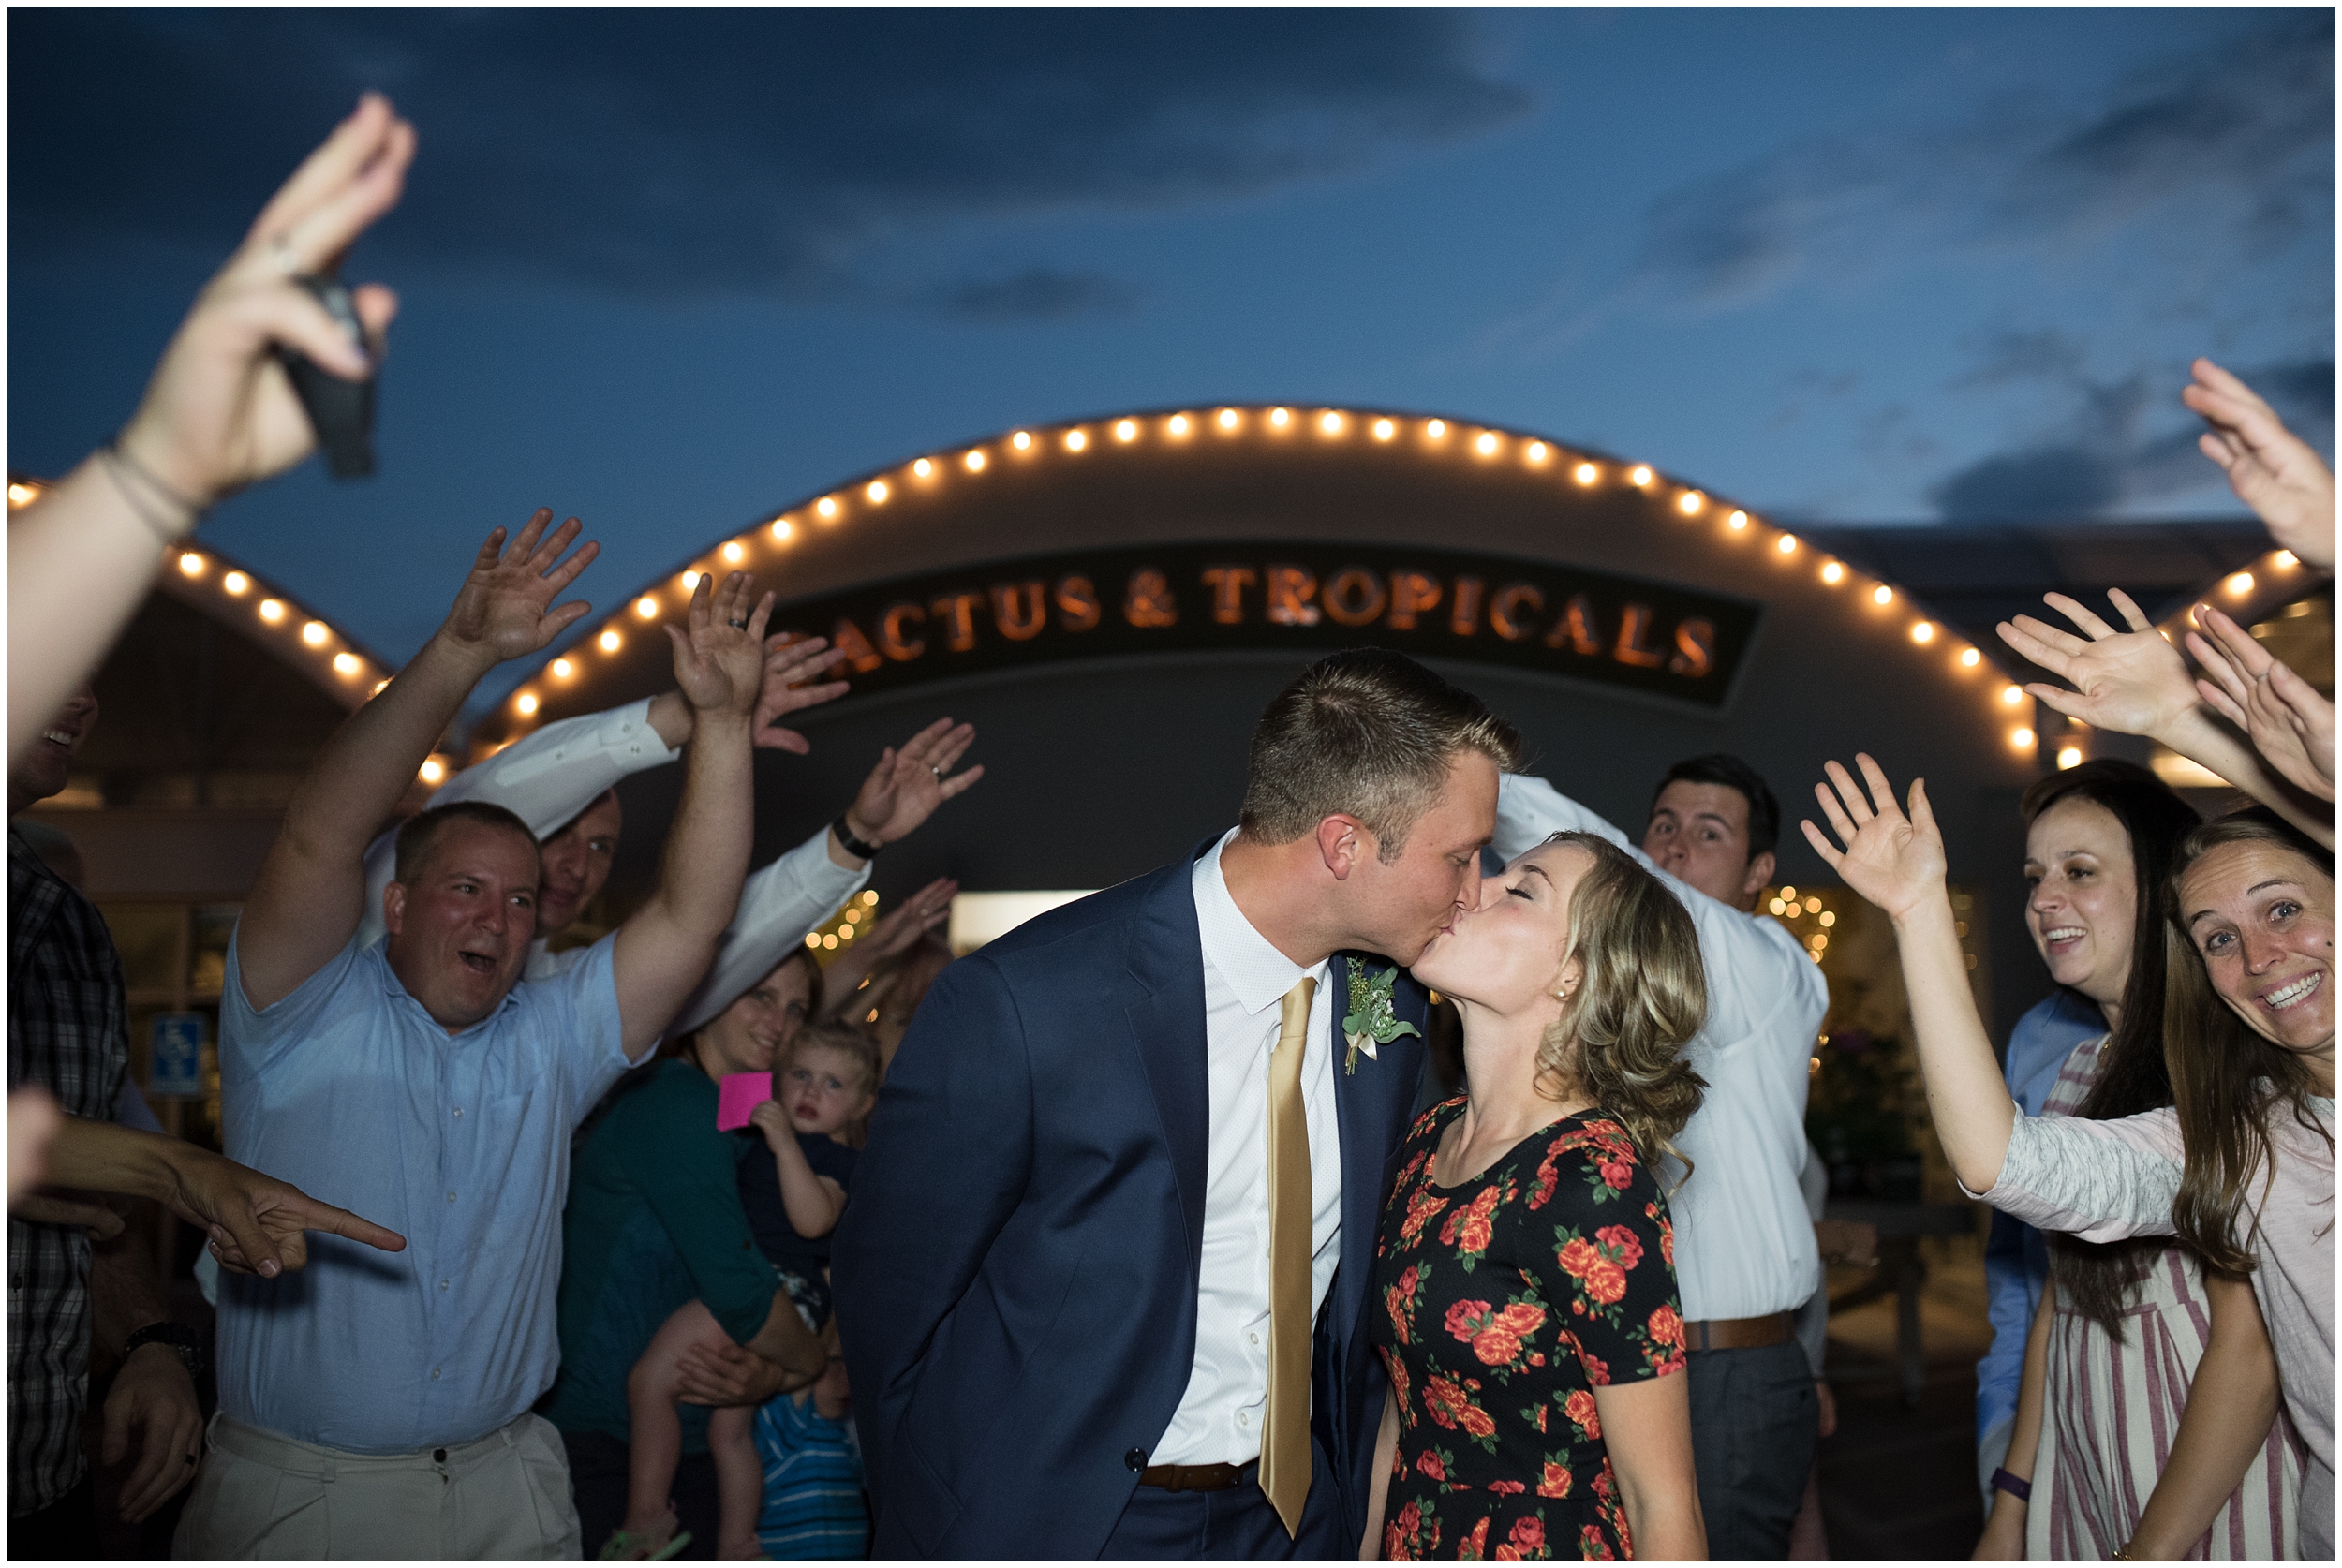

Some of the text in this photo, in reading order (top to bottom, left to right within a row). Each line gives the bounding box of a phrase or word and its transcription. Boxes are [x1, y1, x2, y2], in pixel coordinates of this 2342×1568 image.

[774, 565, 1716, 690] ACTUS & TROPICALS
